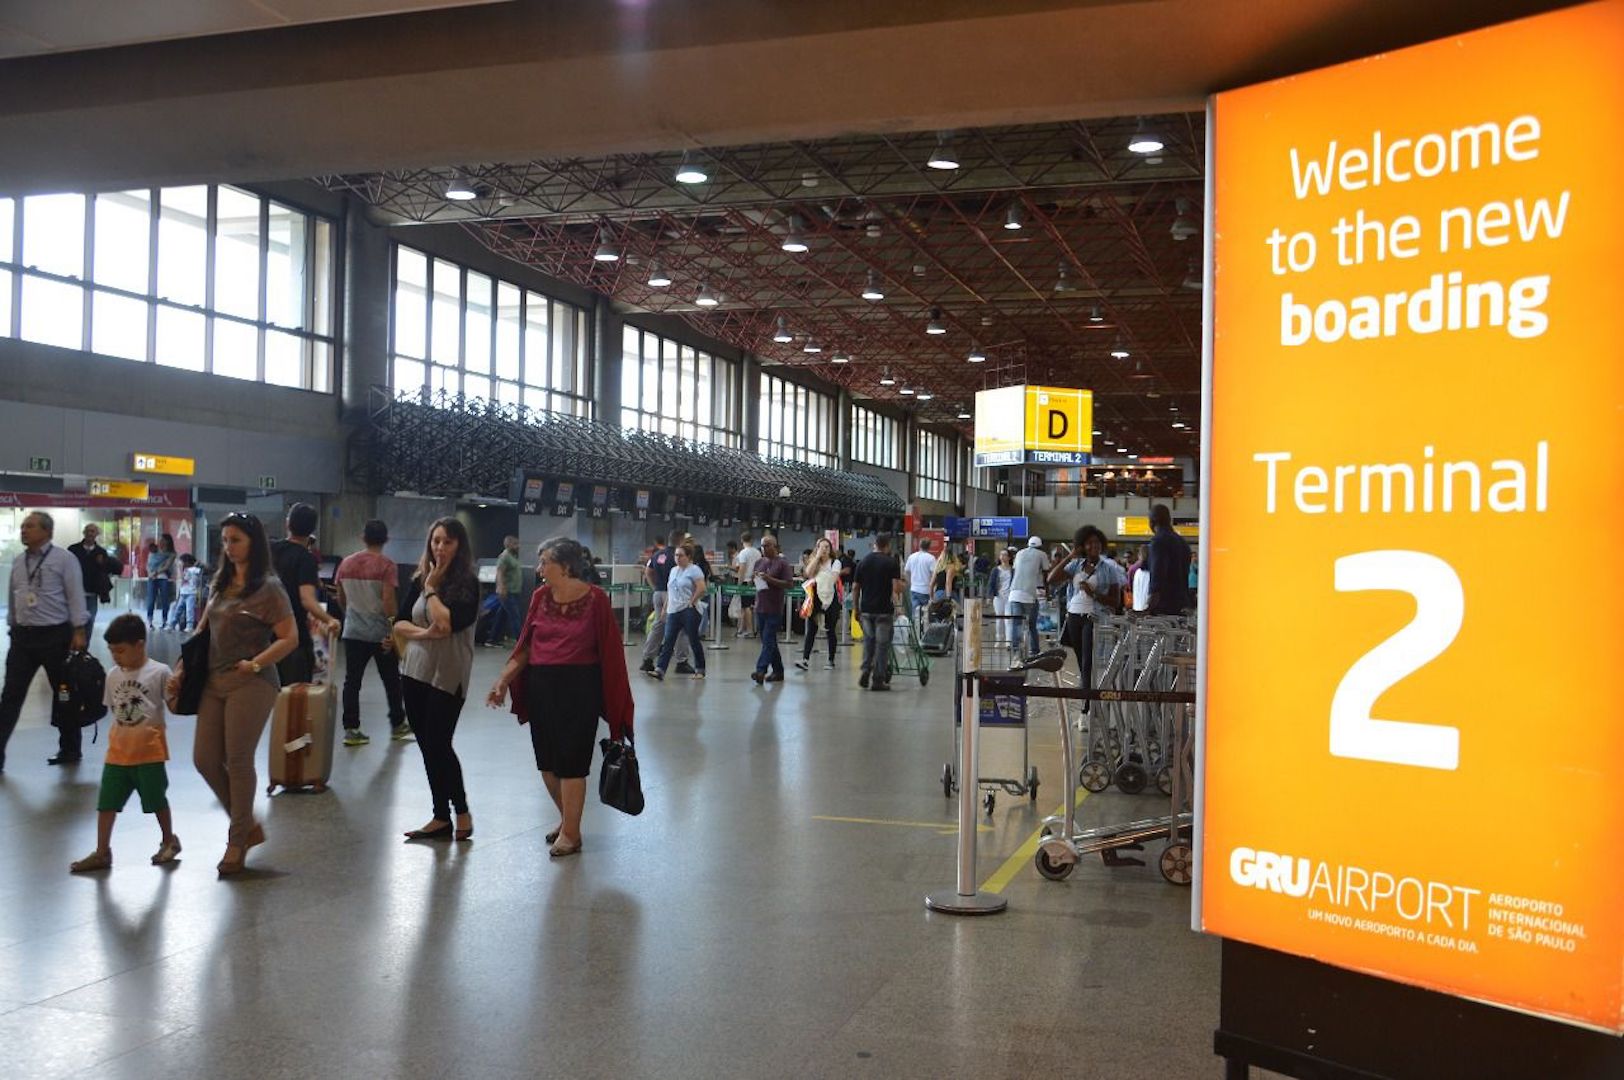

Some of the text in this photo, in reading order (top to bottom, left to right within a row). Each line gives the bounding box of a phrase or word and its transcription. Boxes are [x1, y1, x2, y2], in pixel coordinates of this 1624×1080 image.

[1289, 114, 1541, 200] Welcome
[1265, 190, 1571, 275] to the new
[1280, 271, 1551, 347] boarding
[1047, 409, 1068, 439] D
[1033, 450, 1082, 463] TERMINAL 2
[1253, 440, 1549, 514] Terminal
[1329, 549, 1465, 771] 2
[1488, 892, 1564, 917] AEROPORTO
[1488, 908, 1587, 938] INTERNACIONAL
[1308, 908, 1323, 921] UM
[1324, 912, 1353, 928] NOVO
[1354, 918, 1416, 941] AEROPORTO
[1416, 930, 1425, 944] A
[1427, 933, 1456, 949] CADA
[1487, 923, 1576, 953] DE SÃO PAULO
